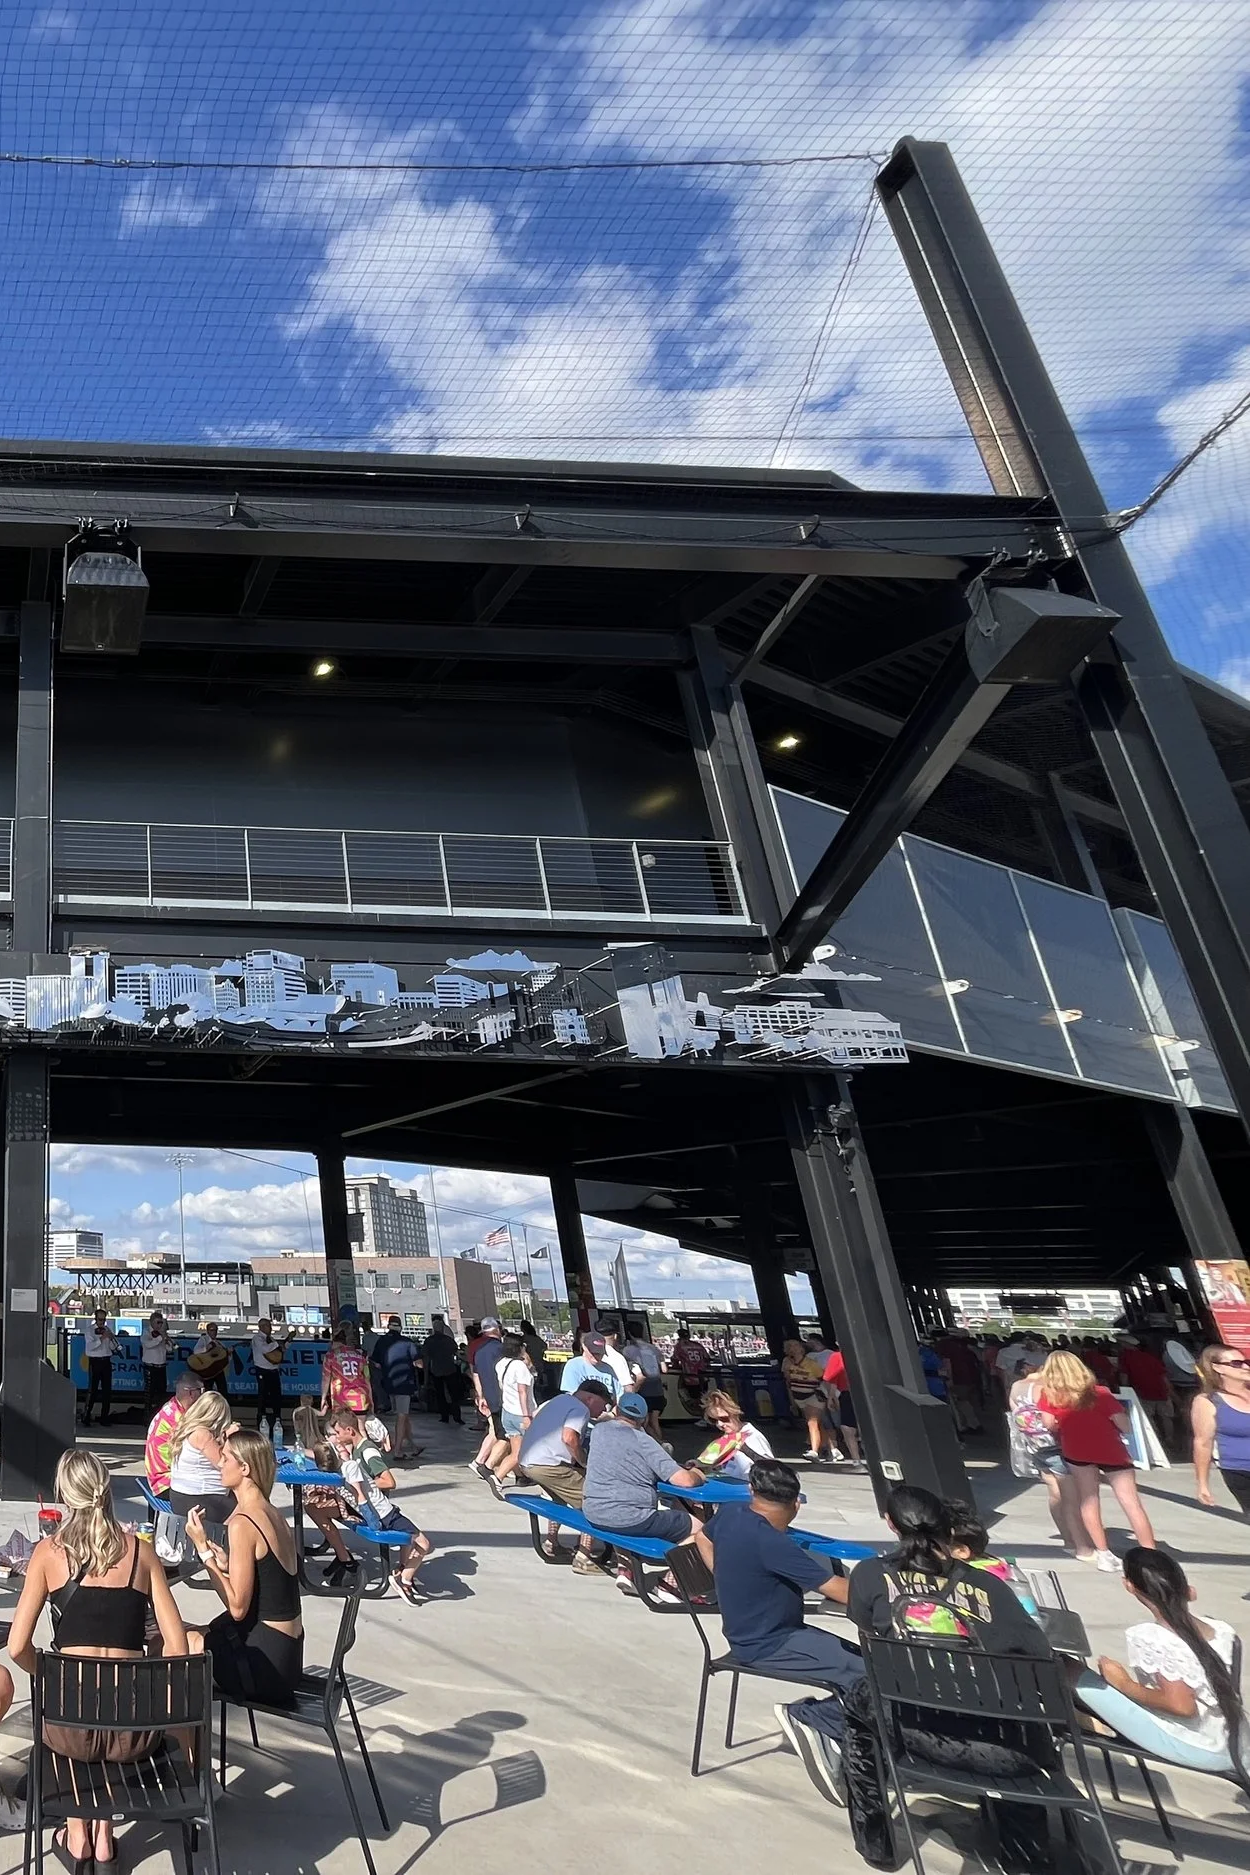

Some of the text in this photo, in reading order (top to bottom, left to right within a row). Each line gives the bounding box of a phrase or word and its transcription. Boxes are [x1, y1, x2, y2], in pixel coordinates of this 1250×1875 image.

[86, 1286, 112, 1297] EQUITY
[114, 1287, 135, 1296] BANK
[196, 1288, 216, 1296] BANK
[687, 1350, 701, 1361] 26
[341, 1360, 359, 1376] 26
[291, 1383, 320, 1392] HOUSE
